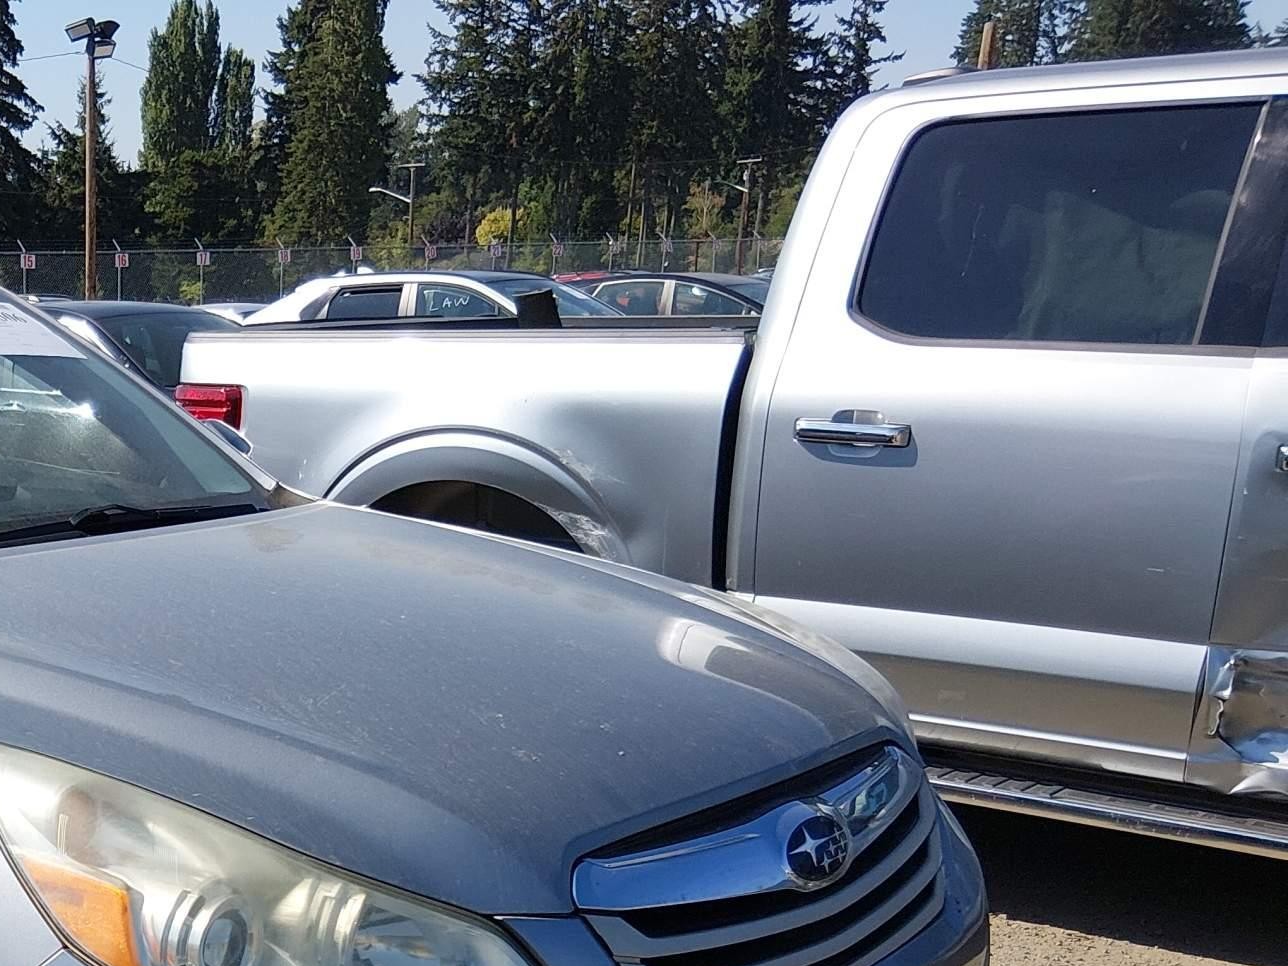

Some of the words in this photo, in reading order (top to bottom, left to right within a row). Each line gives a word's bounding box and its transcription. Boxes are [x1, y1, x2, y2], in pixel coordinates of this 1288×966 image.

[280, 250, 290, 262] 18
[352, 247, 362, 259] 19
[426, 246, 437, 258] 20
[553, 244, 564, 256] 22
[23, 255, 34, 268] 15
[117, 254, 128, 267] 16
[198, 252, 208, 265] 17
[429, 295, 470, 312] LAW
